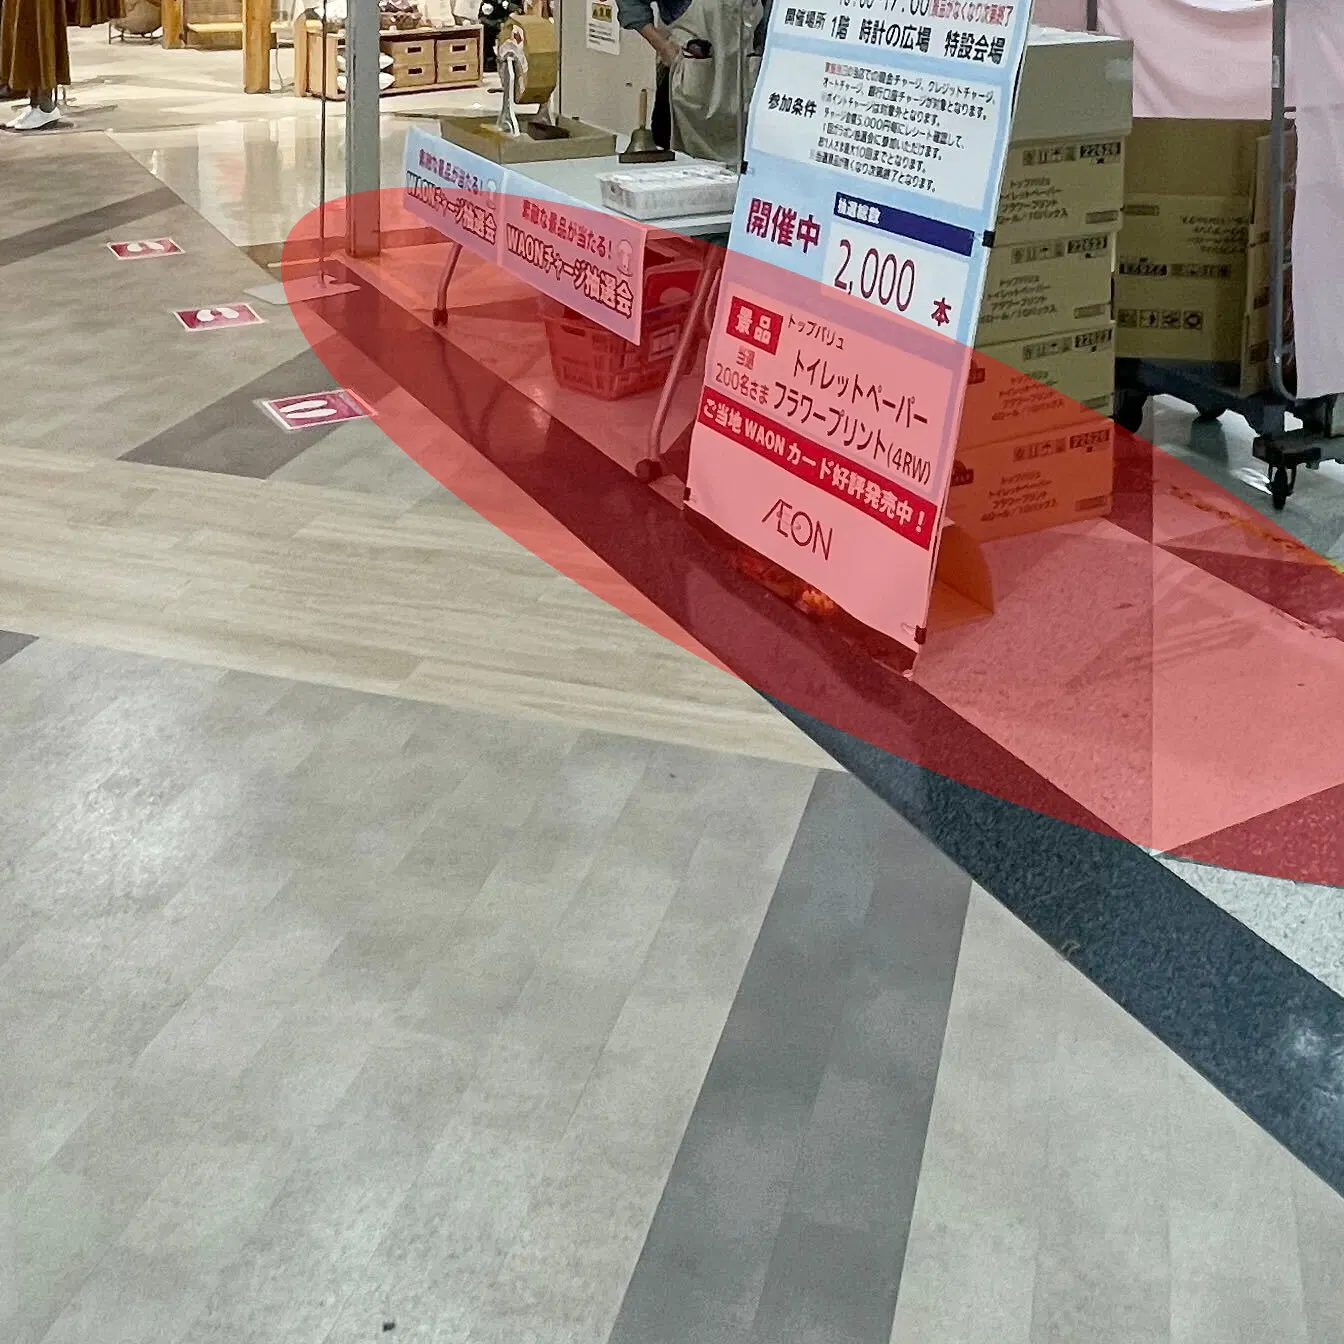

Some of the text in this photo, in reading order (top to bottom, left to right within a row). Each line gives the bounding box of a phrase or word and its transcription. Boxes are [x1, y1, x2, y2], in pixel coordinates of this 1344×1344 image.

[784, 7, 1006, 65] 開催場所 1階 時計の広場 特設会場
[768, 91, 818, 119] 参加条件
[406, 170, 497, 245] WAONチャージ抽選会
[746, 197, 821, 254] 開催中
[506, 223, 634, 319] WAONチャージ抽選会
[834, 239, 952, 327] 2,000 本
[734, 306, 772, 345] 景品
[788, 313, 844, 350] トップバリュ
[715, 363, 769, 405] 200名さま
[793, 349, 928, 427] トイレットペーパー
[703, 399, 925, 533] ご当地 WAON カード好評発売中!
[773, 381, 932, 486] フラワープリント(4RW)
